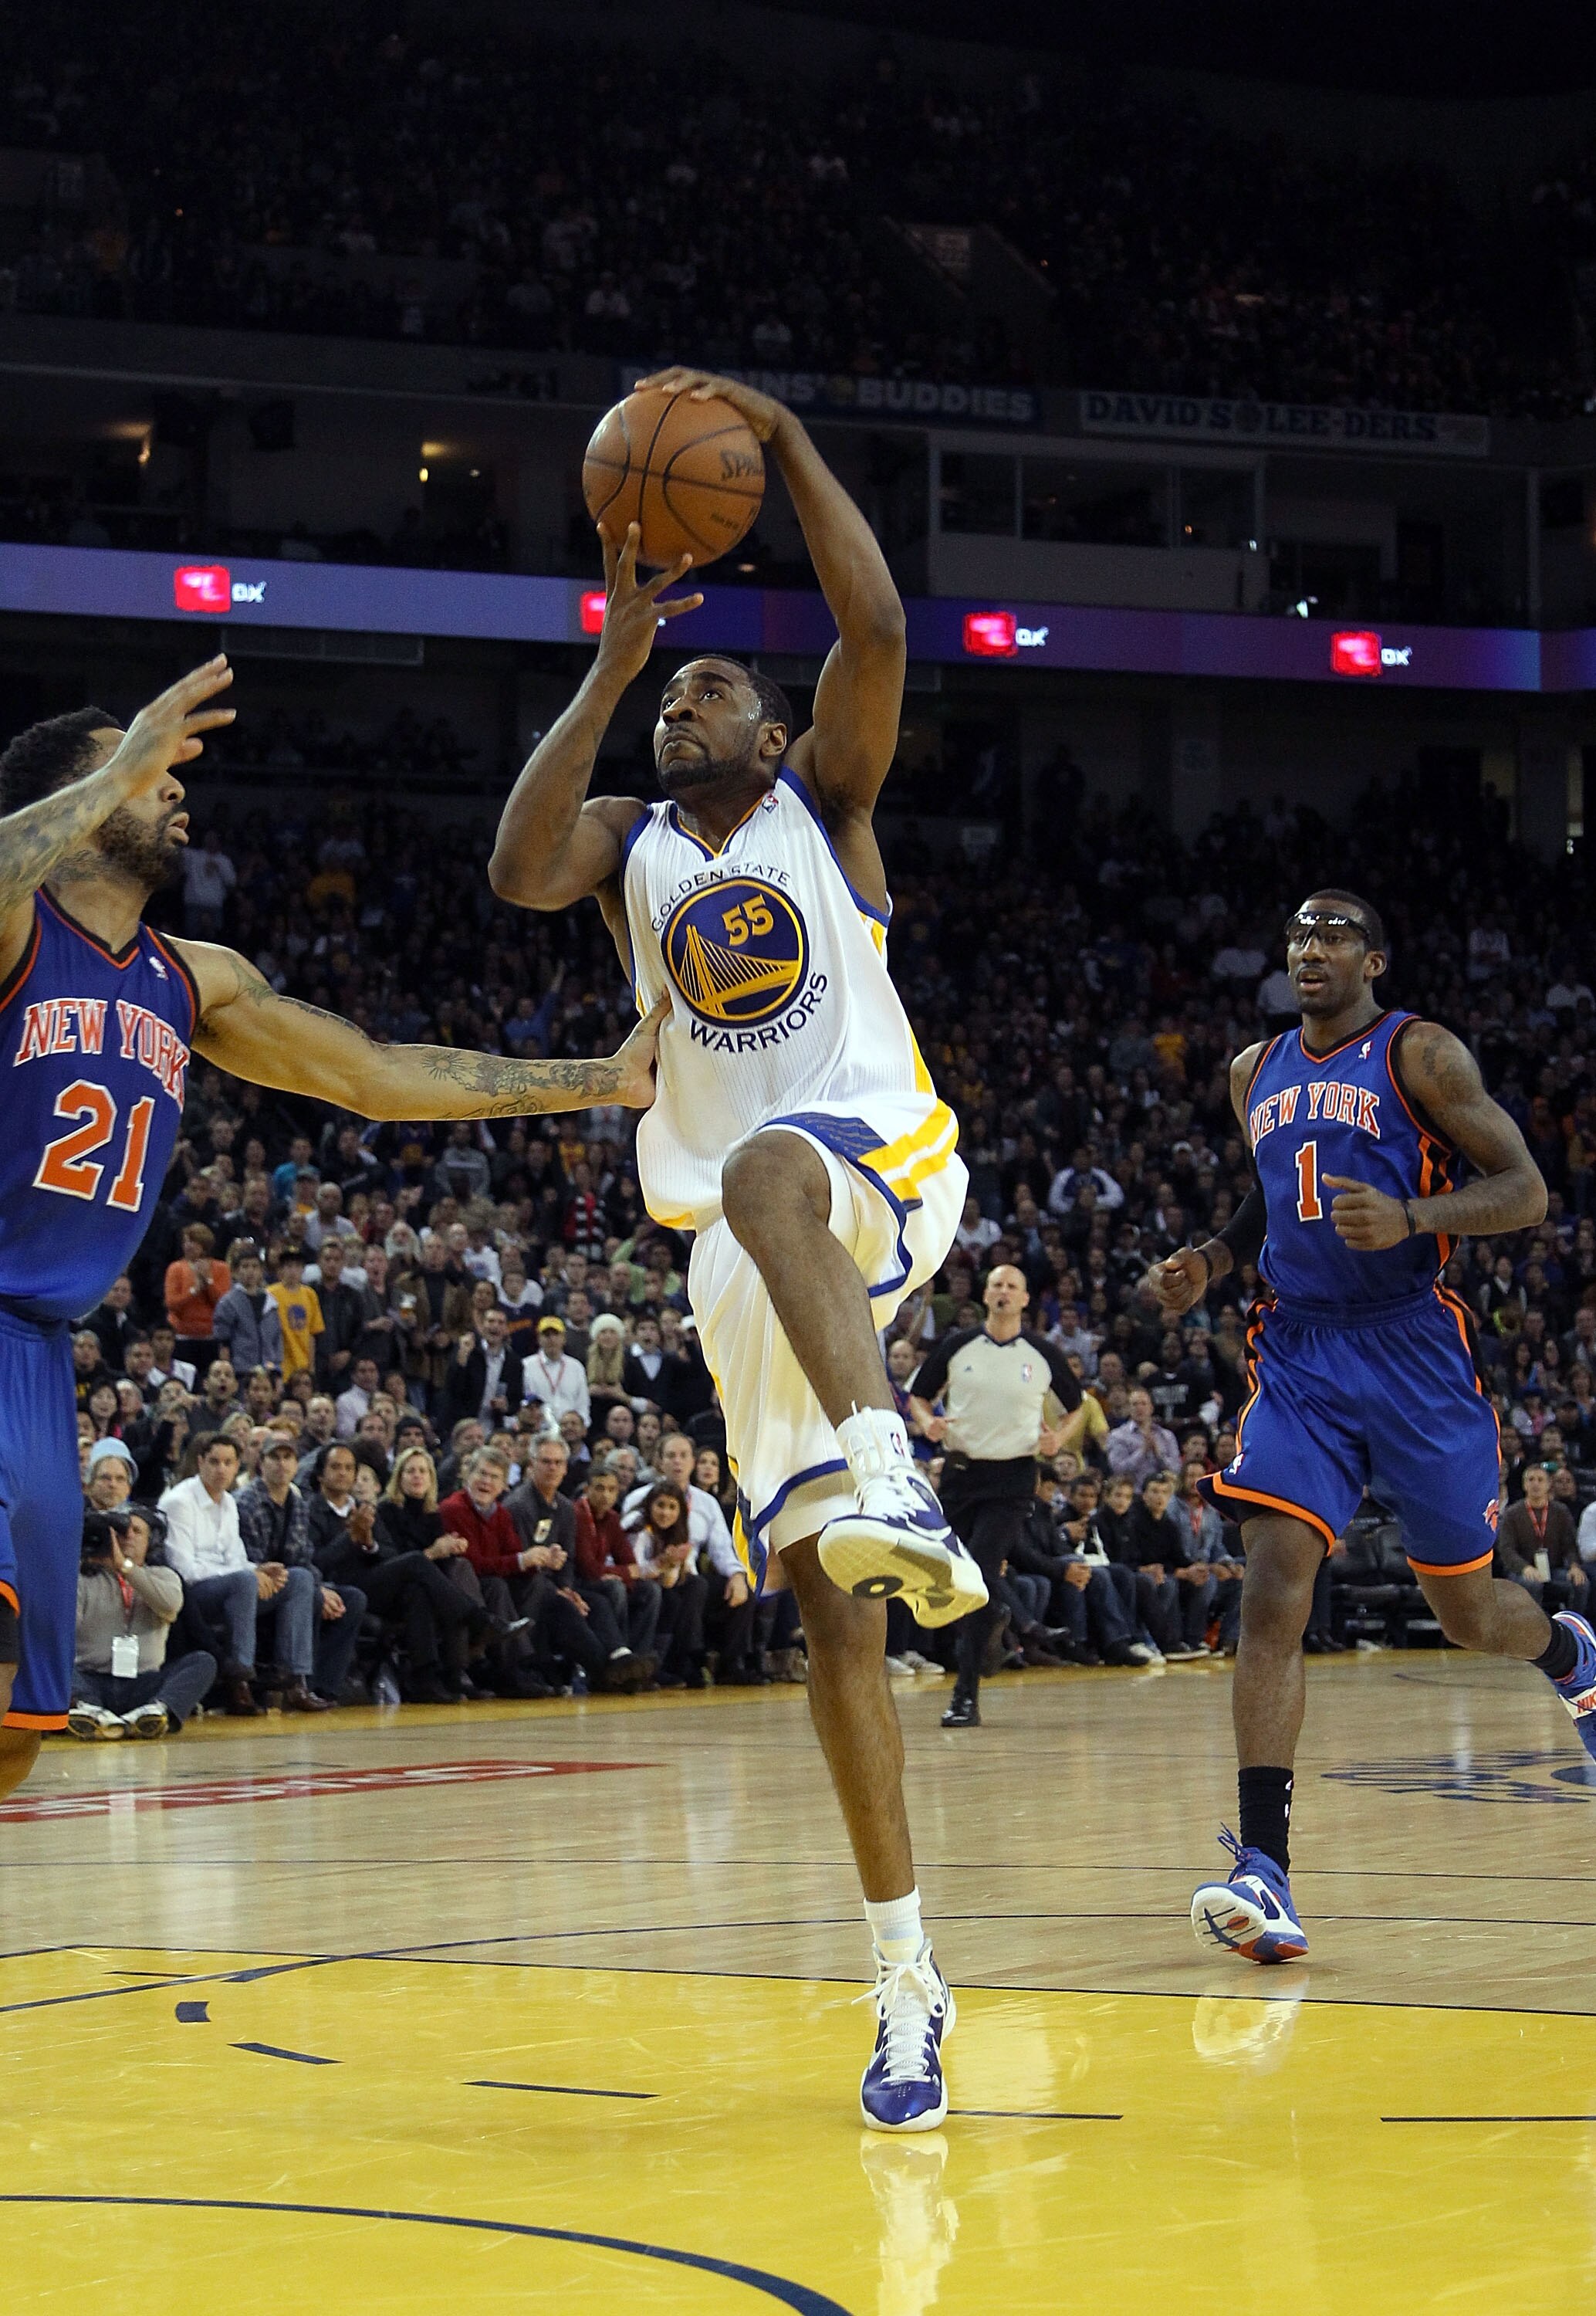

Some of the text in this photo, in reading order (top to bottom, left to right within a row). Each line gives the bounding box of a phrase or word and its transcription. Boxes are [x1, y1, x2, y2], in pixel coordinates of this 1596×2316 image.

[857, 377, 1035, 422] BUDDIES
[651, 862, 791, 931] GOLDEN STATE
[722, 893, 774, 946] 55
[689, 970, 828, 1053] WARRIORS
[12, 997, 191, 1114] NEW YORK
[32, 1078, 155, 1213] 21
[1249, 1081, 1381, 1158] NEW YORK
[1295, 1140, 1324, 1223] 1
